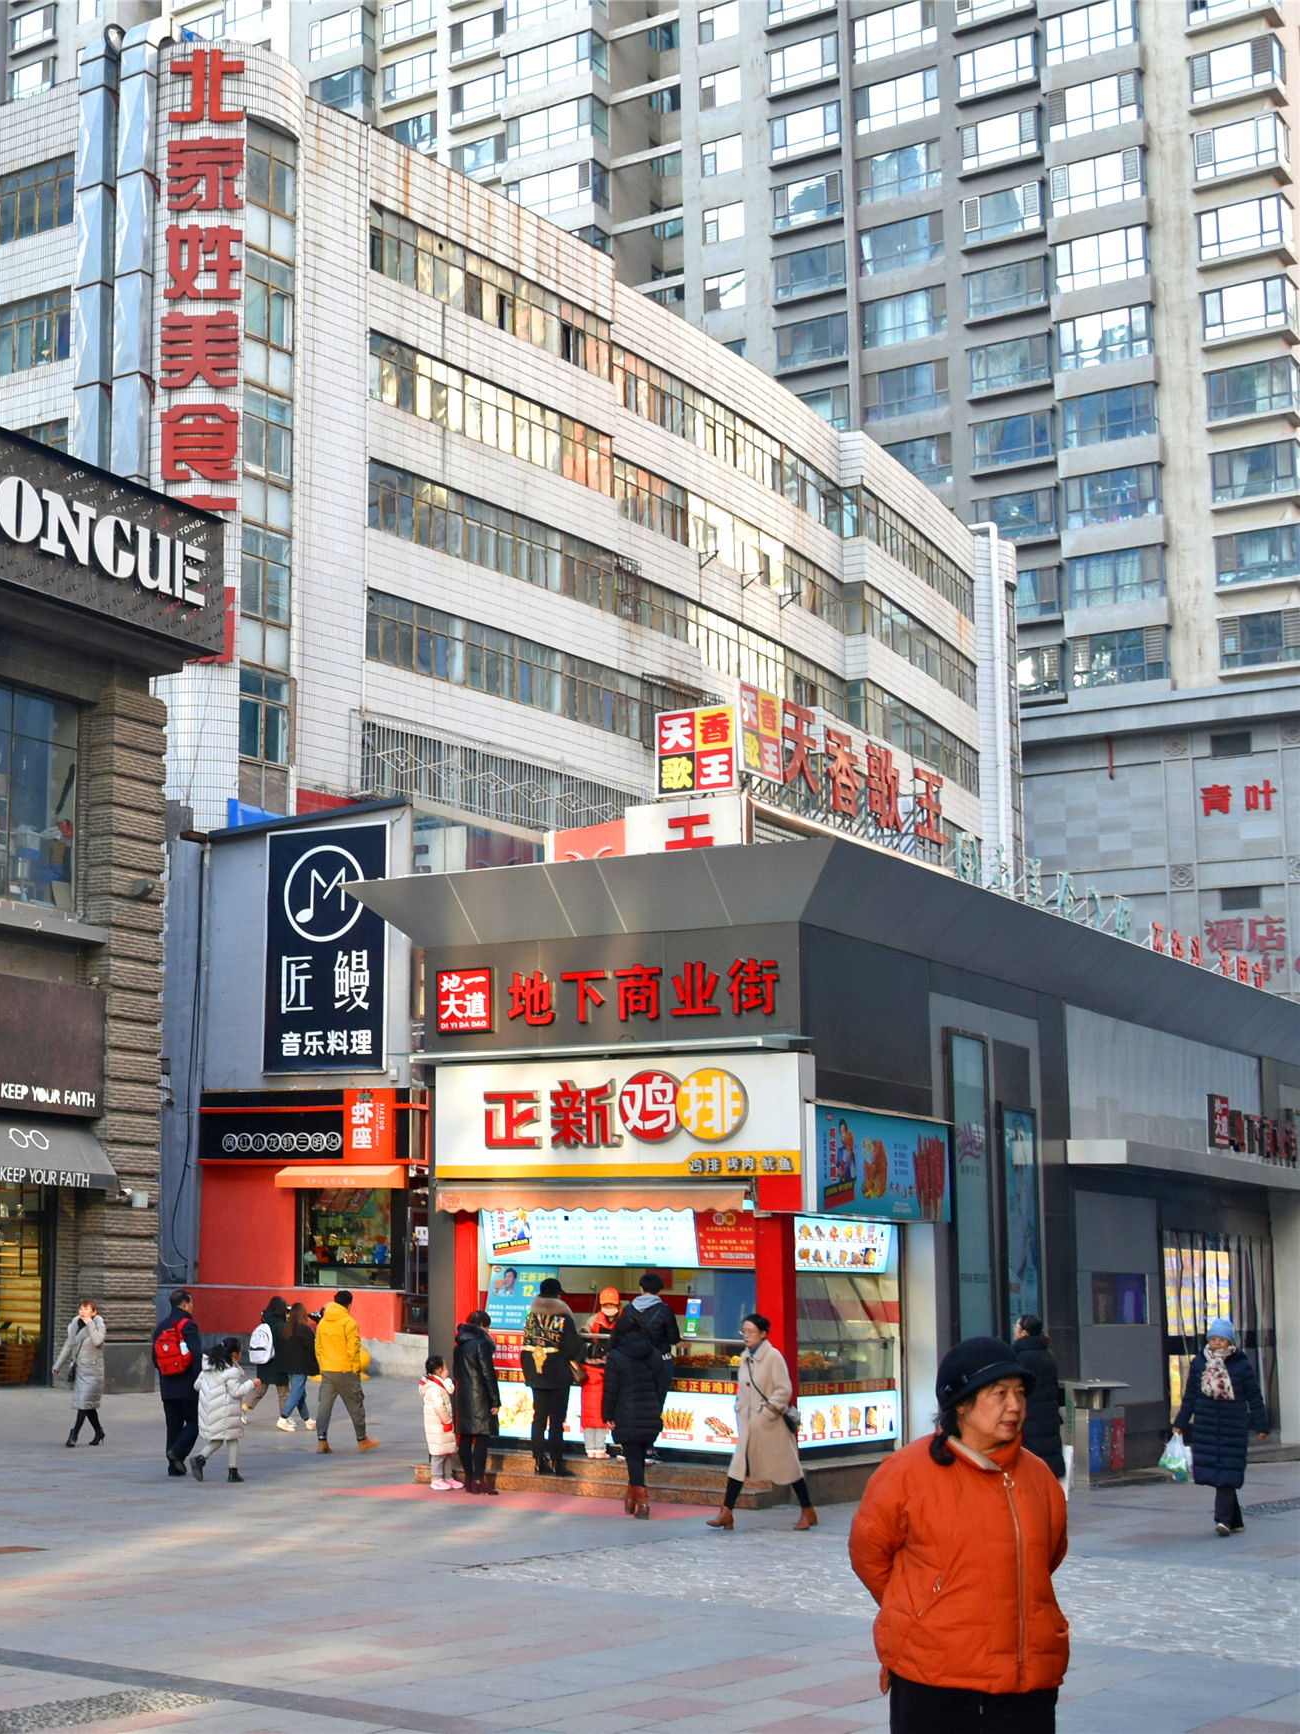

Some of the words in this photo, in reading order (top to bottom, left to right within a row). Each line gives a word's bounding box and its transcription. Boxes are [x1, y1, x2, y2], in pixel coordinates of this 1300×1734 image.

[661, 711, 731, 751] 天香
[661, 752, 731, 790] 歌王
[782, 700, 948, 847] 天香歌王
[1200, 779, 1278, 817] 青叶
[1204, 914, 1286, 953] 酒店
[440, 992, 487, 1020] 大道
[507, 957, 780, 1026] 地下商业街
[281, 1030, 373, 1057] 音乐料理
[470, 1020, 487, 1029] DAO
[0, 1082, 29, 1100] KEEP
[31, 1085, 62, 1105] YOUR
[63, 1089, 96, 1108] FAITH
[482, 1074, 743, 1149] 正新鸡排
[221, 1131, 343, 1153] 网红小龙虾三明治
[351, 1101, 374, 1149] 虾座
[0, 1165, 27, 1182] KEEP
[29, 1168, 58, 1185] YOUR
[60, 1170, 91, 1188] FAITH
[689, 1158, 721, 1173] 鸡排
[727, 1156, 756, 1172] 烤肉
[761, 1156, 794, 1172] 鱿鱼
